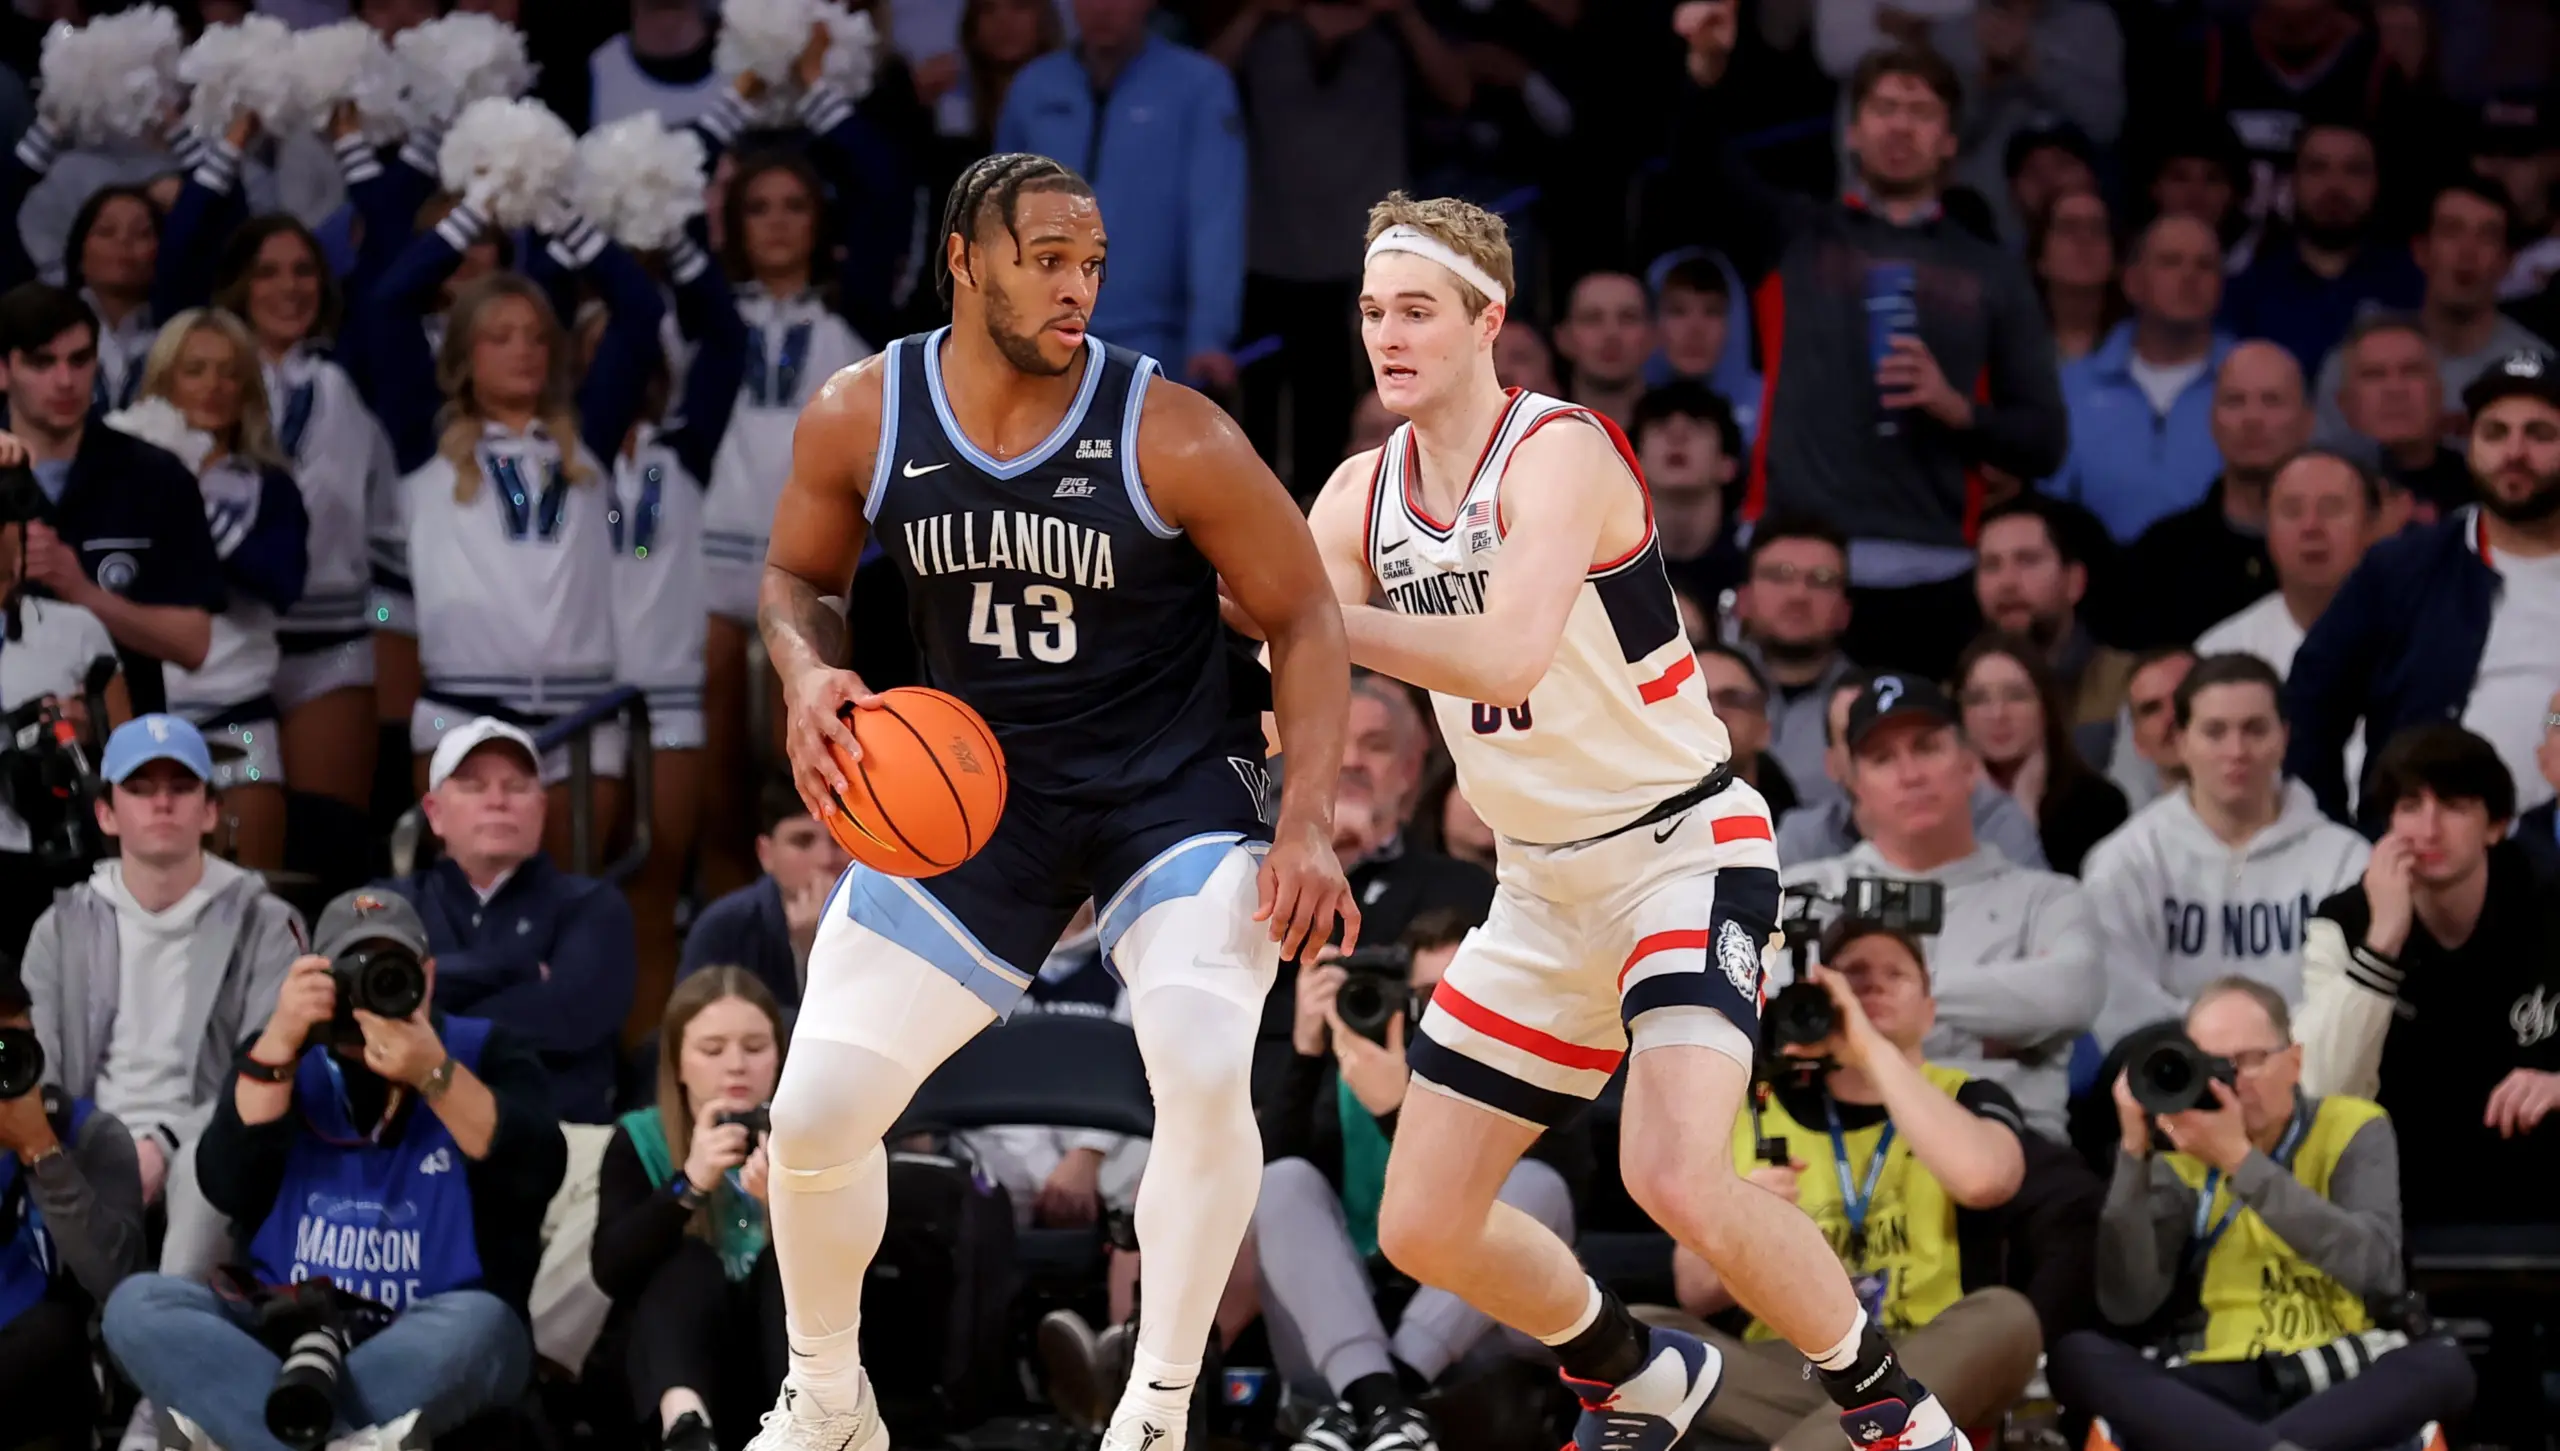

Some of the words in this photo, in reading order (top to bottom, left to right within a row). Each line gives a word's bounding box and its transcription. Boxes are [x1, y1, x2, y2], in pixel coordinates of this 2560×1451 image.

[1079, 439, 1092, 449] BE
[1095, 439, 1112, 449] THE
[1075, 448, 1113, 459] CHANGE
[1059, 477, 1090, 486] BIG
[1055, 486, 1097, 495] EAST
[1472, 530, 1488, 541] BIG
[904, 510, 1115, 590] VILLANOVA
[1472, 537, 1492, 550] EAST
[1383, 561, 1393, 571] BE
[1395, 558, 1410, 569] THE
[1382, 566, 1414, 580] CHANGE
[968, 581, 1078, 664] 43
[294, 1213, 421, 1273] MADISON
